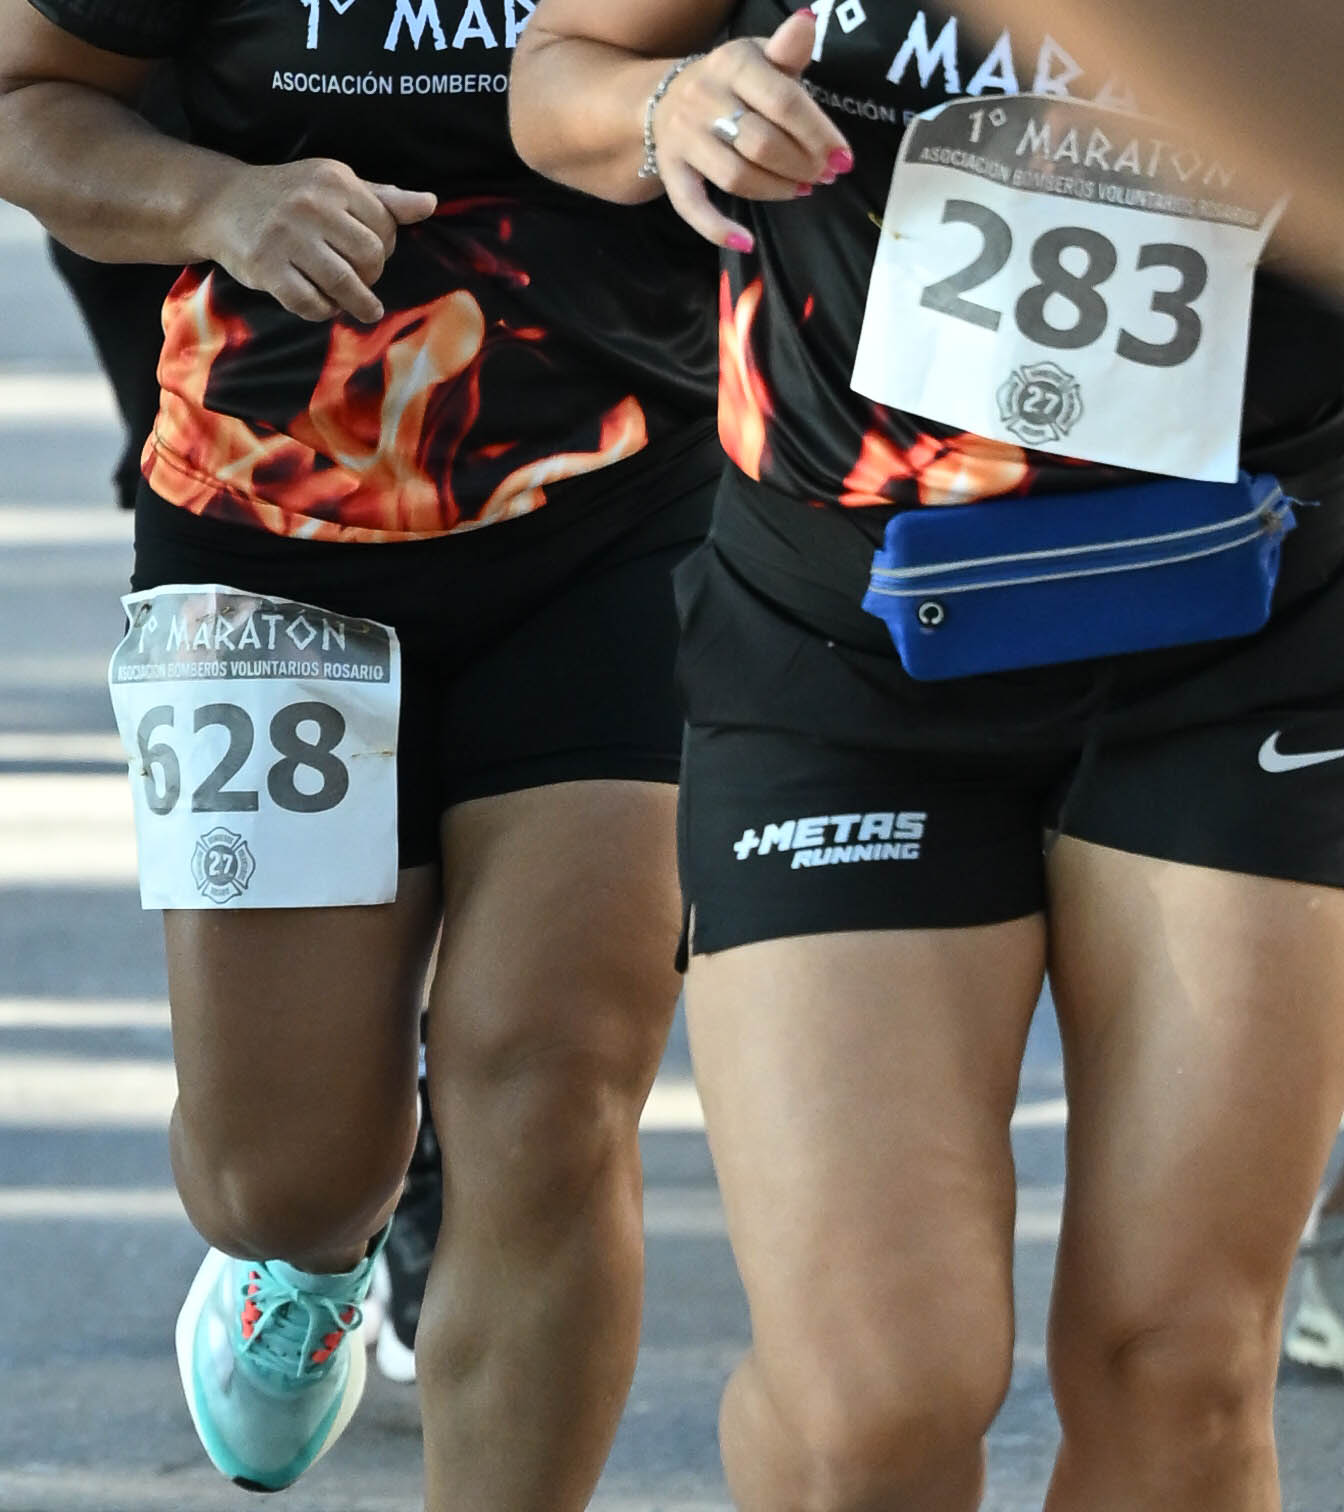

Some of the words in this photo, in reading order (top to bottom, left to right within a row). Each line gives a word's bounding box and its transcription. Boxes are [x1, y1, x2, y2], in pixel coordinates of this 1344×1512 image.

[272, 71, 392, 94] ASOCIACIÓN
[400, 74, 512, 94] BOMBERO
[919, 199, 1208, 368] 283
[1023, 384, 1061, 415] 27
[167, 660, 227, 678] BOMBEROS
[230, 659, 319, 678] VOLUNTARIOS
[323, 662, 384, 681] ROSARIO
[137, 701, 349, 816] 628
[208, 850, 233, 877] 27
[790, 842, 921, 870] RUNNING
